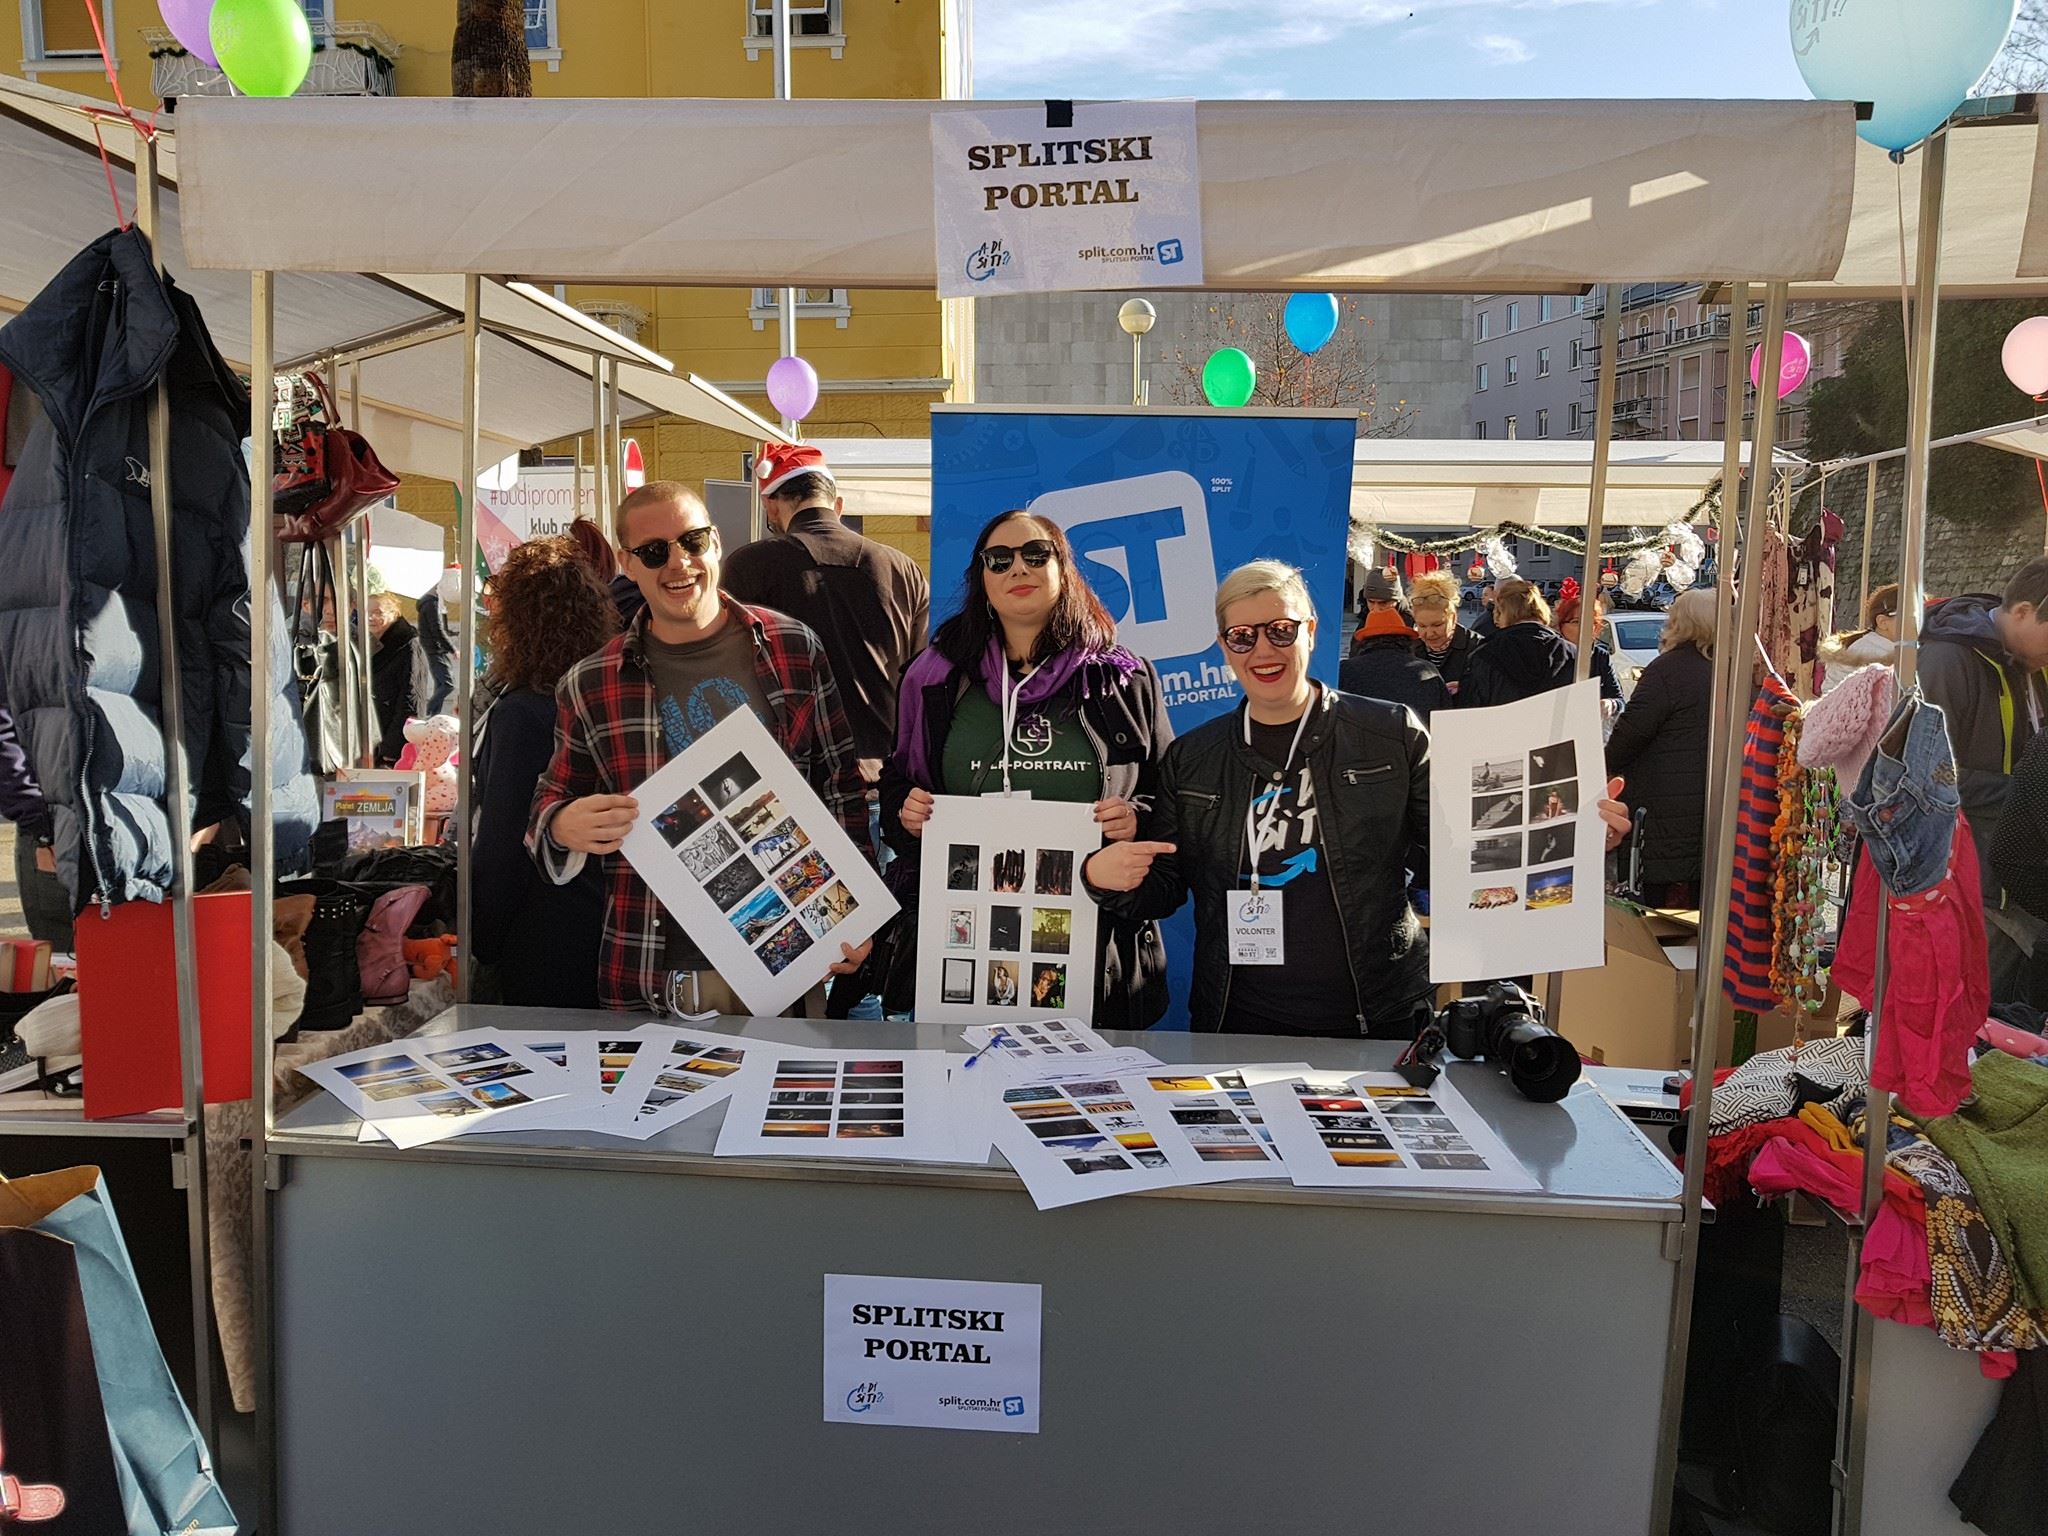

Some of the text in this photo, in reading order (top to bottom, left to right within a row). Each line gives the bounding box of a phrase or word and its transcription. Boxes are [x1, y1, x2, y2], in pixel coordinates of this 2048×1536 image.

[968, 136, 1153, 171] SPLITSKI
[984, 179, 1139, 211] PORTAL
[1078, 242, 1180, 262] split.com.hr ST
[1211, 477, 1233, 485] 100%
[531, 517, 558, 535] klub
[970, 760, 1086, 771] HP-PORTRAIT
[357, 802, 394, 813] ZEMLJA
[852, 1303, 1005, 1332] SPLITSKI
[864, 1338, 991, 1364] PORTAL
[938, 1395, 1021, 1413] split.com.hr ST
